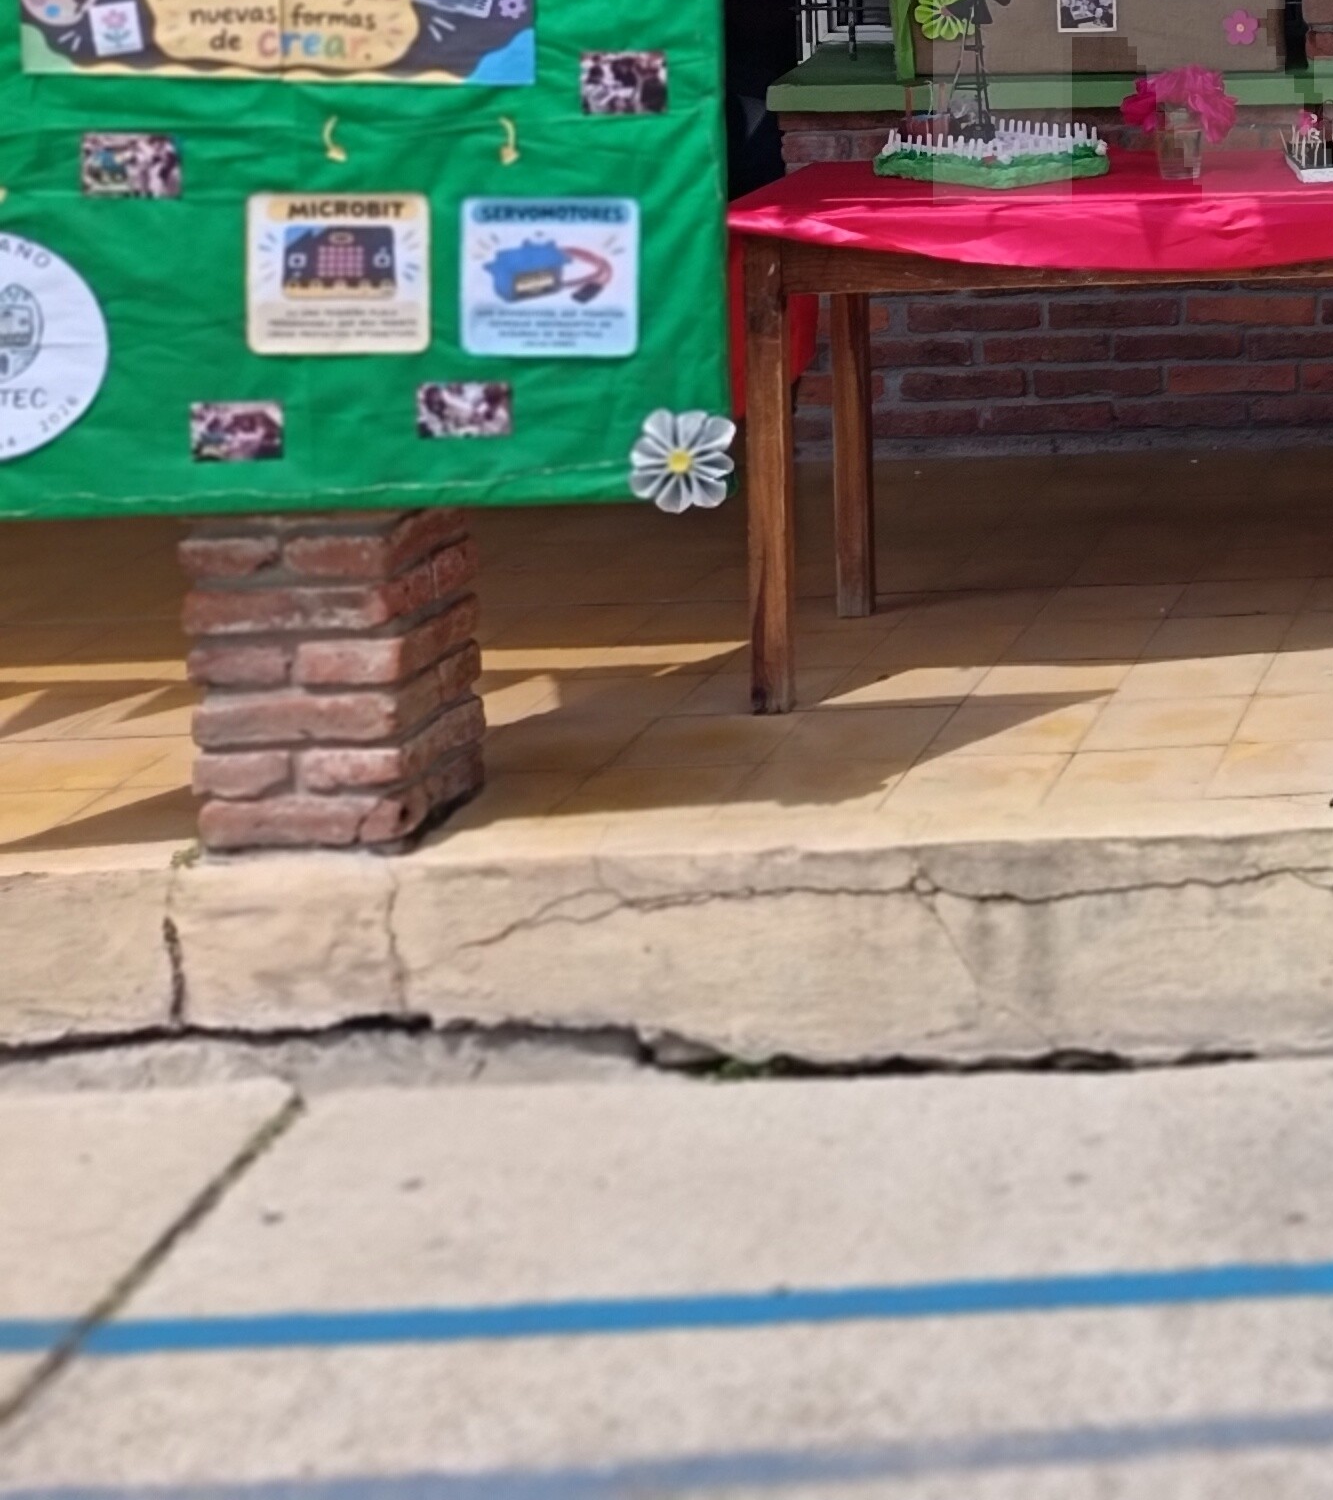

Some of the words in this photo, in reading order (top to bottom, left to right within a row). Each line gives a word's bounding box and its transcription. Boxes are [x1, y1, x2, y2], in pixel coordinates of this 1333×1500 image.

[189, 6, 277, 25] nuevas
[291, 3, 376, 31] formas
[209, 29, 241, 51] de
[287, 201, 406, 219] MICROBIT
